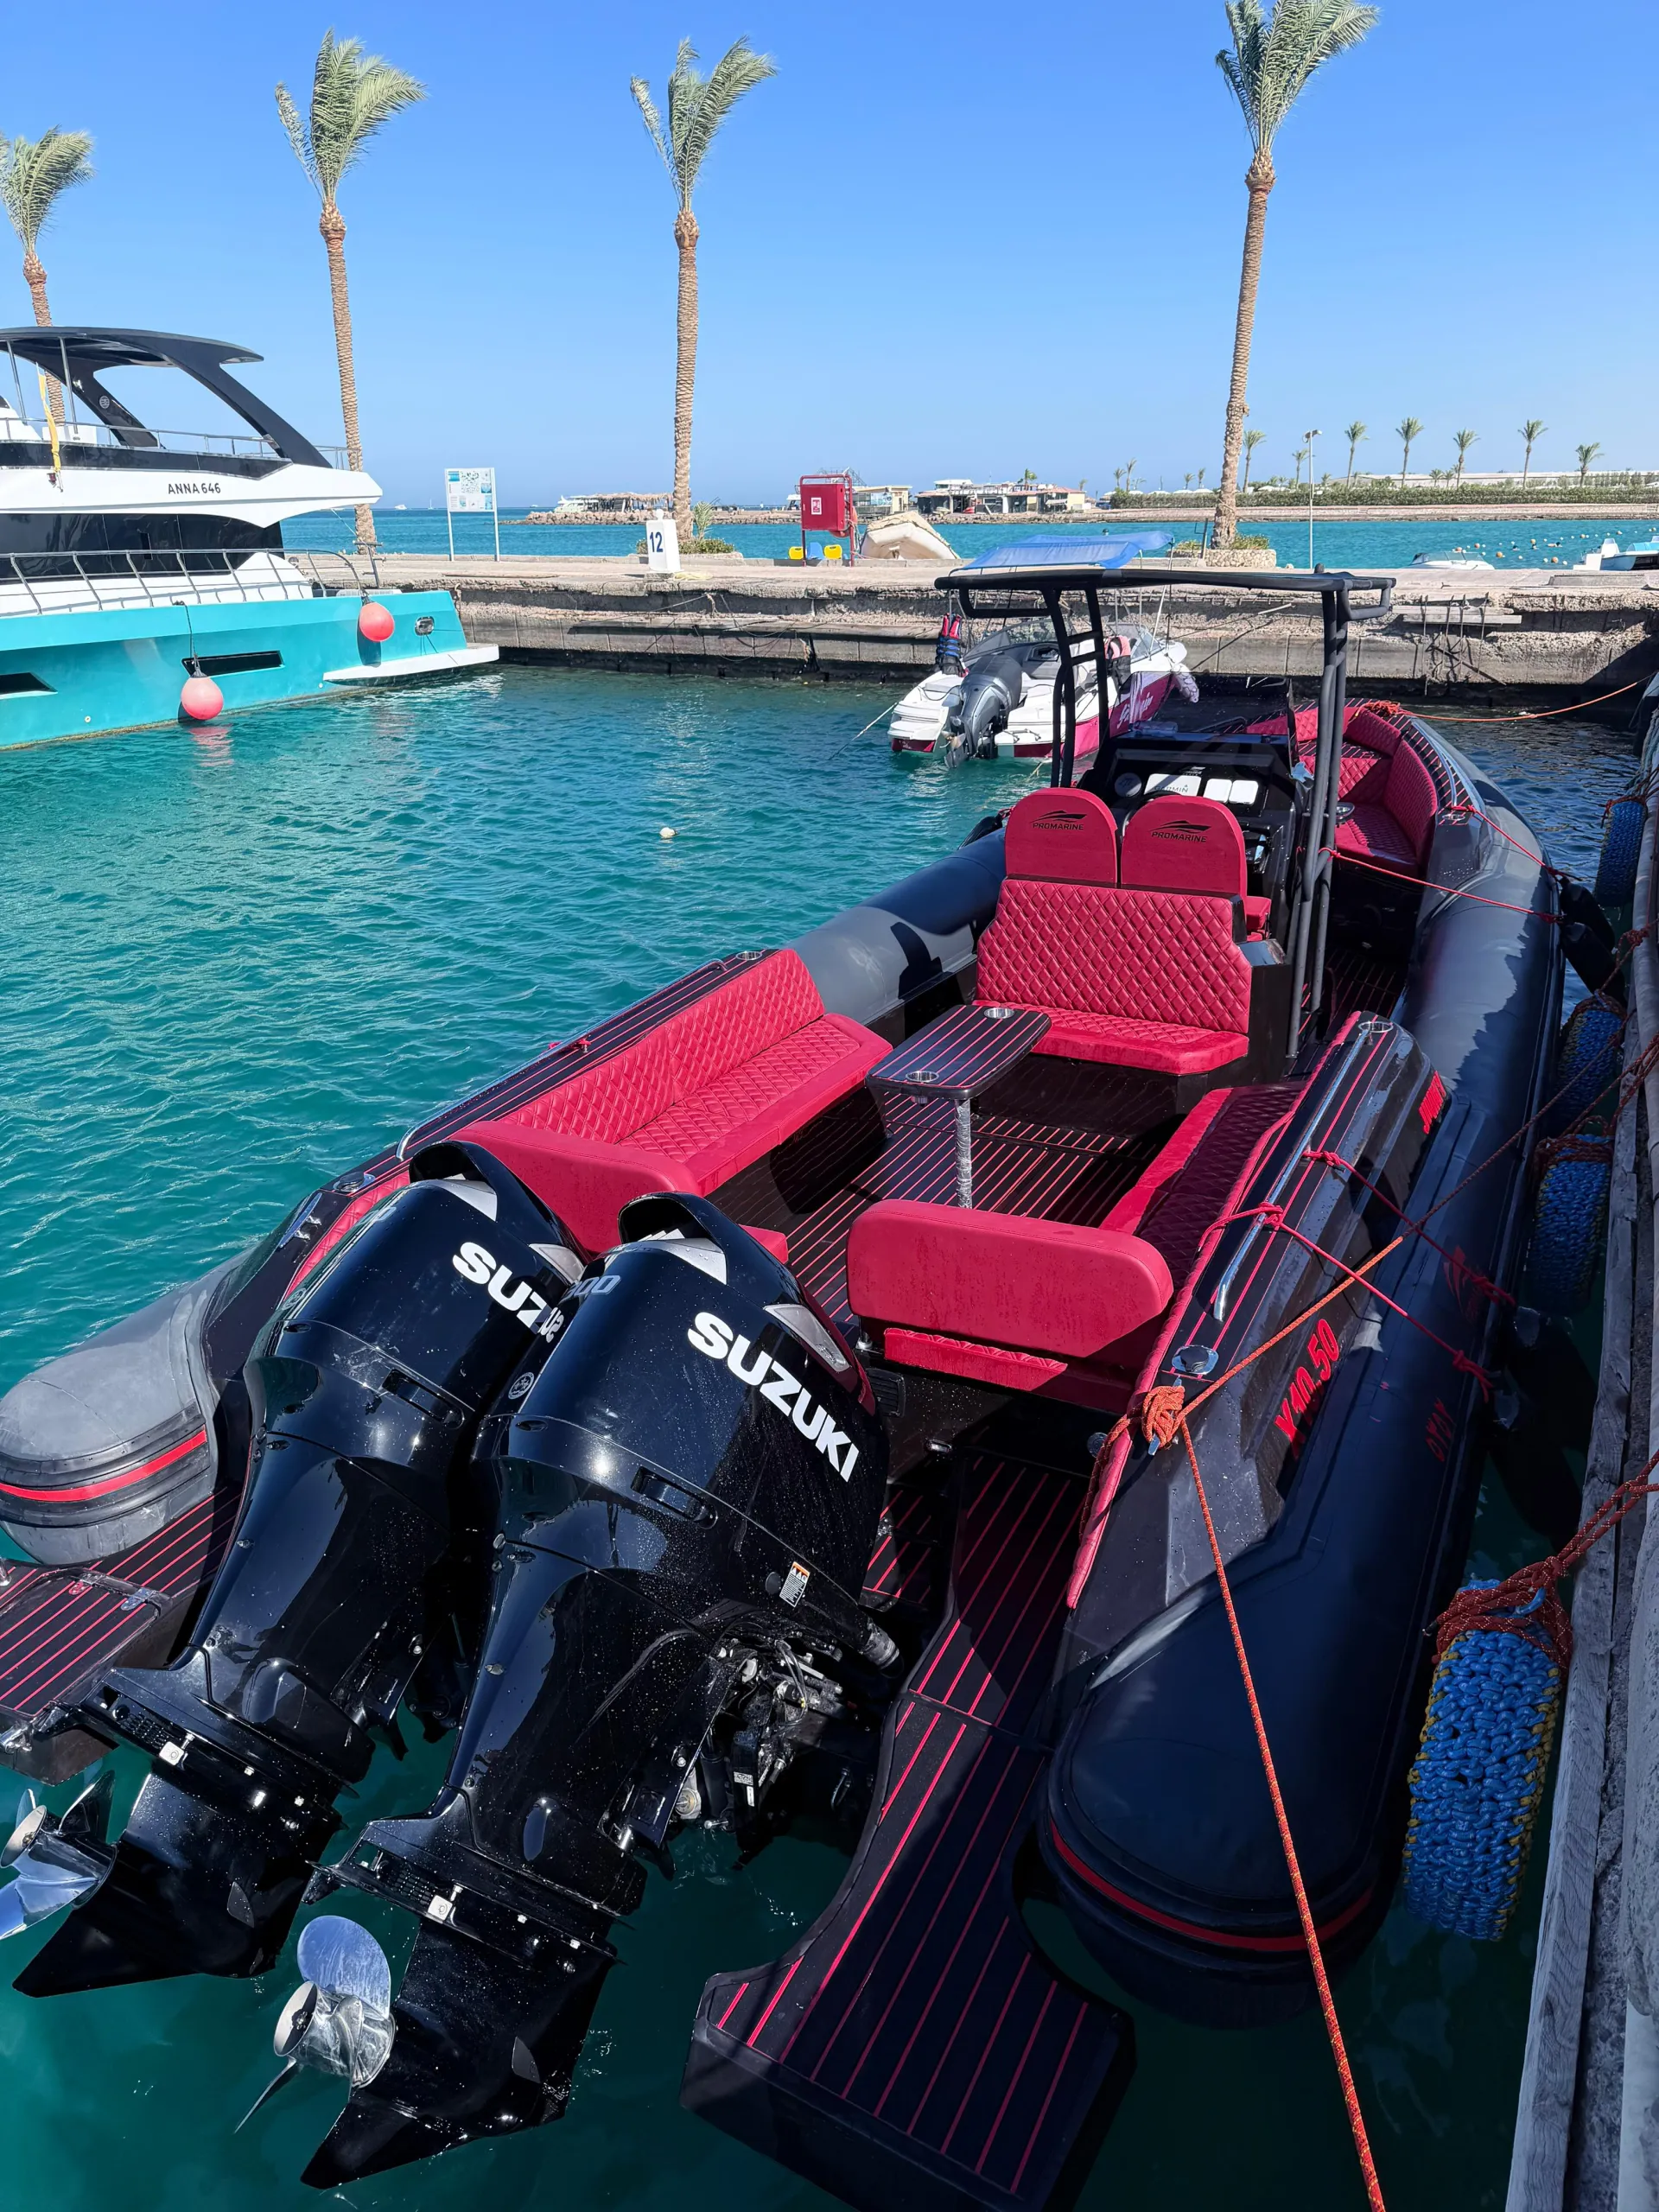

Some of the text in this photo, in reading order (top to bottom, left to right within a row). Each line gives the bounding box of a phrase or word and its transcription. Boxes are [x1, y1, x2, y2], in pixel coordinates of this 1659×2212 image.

[168, 482, 221, 494] ANNA 646
[650, 531, 664, 553] 12
[1033, 822, 1084, 830] PROMARINE
[1151, 830, 1207, 843] PROMARINE
[452, 1242, 553, 1335] SUZ
[687, 1312, 860, 1483] SUZUKI
